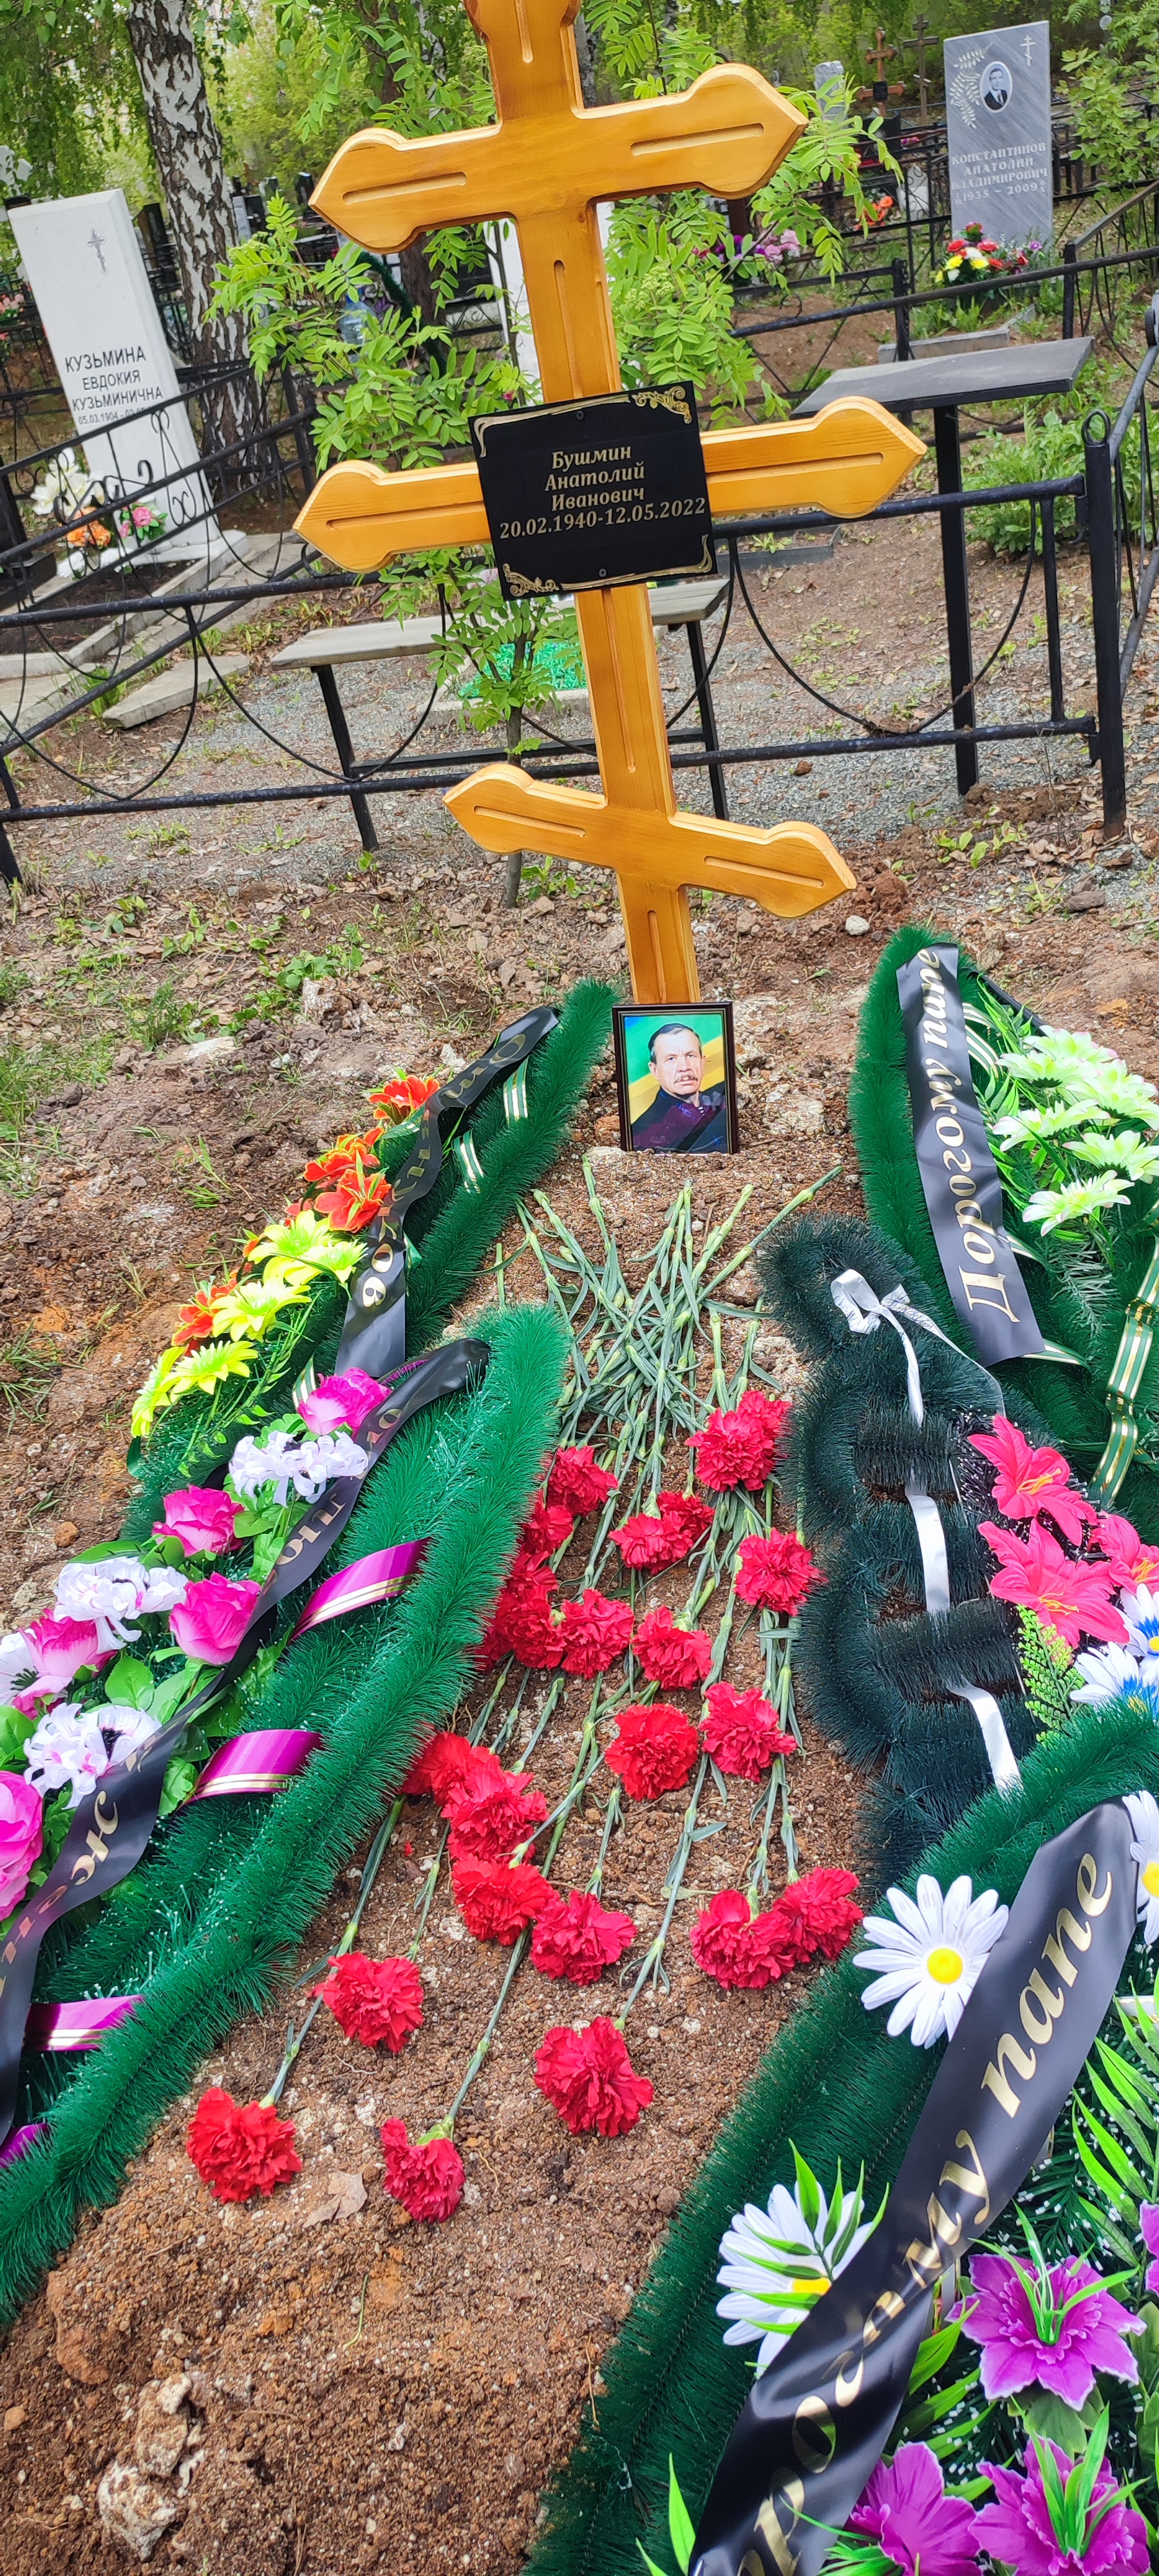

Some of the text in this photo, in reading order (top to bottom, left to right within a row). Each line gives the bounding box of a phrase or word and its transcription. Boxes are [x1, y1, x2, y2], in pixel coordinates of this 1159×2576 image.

[952, 142, 1046, 165] КОНСТАНТИНОВ
[952, 167, 1048, 190] ВЛАДИМИРОВИЧ
[1007, 182, 1037, 195] 2009
[65, 346, 146, 373] КУЗЬМИНА
[82, 370, 141, 392] ЕВДОКИЯ
[72, 386, 164, 412] КУЗЬМИНИЧНА
[552, 446, 632, 471] Бушмин
[545, 461, 645, 491] Анатолий
[551, 486, 645, 511] Иванович
[500, 497, 706, 539] 20.02.1940-12.05.2022
[919, 947, 1020, 1323] Дорогому папе
[981, 1853, 1113, 2119] папе
